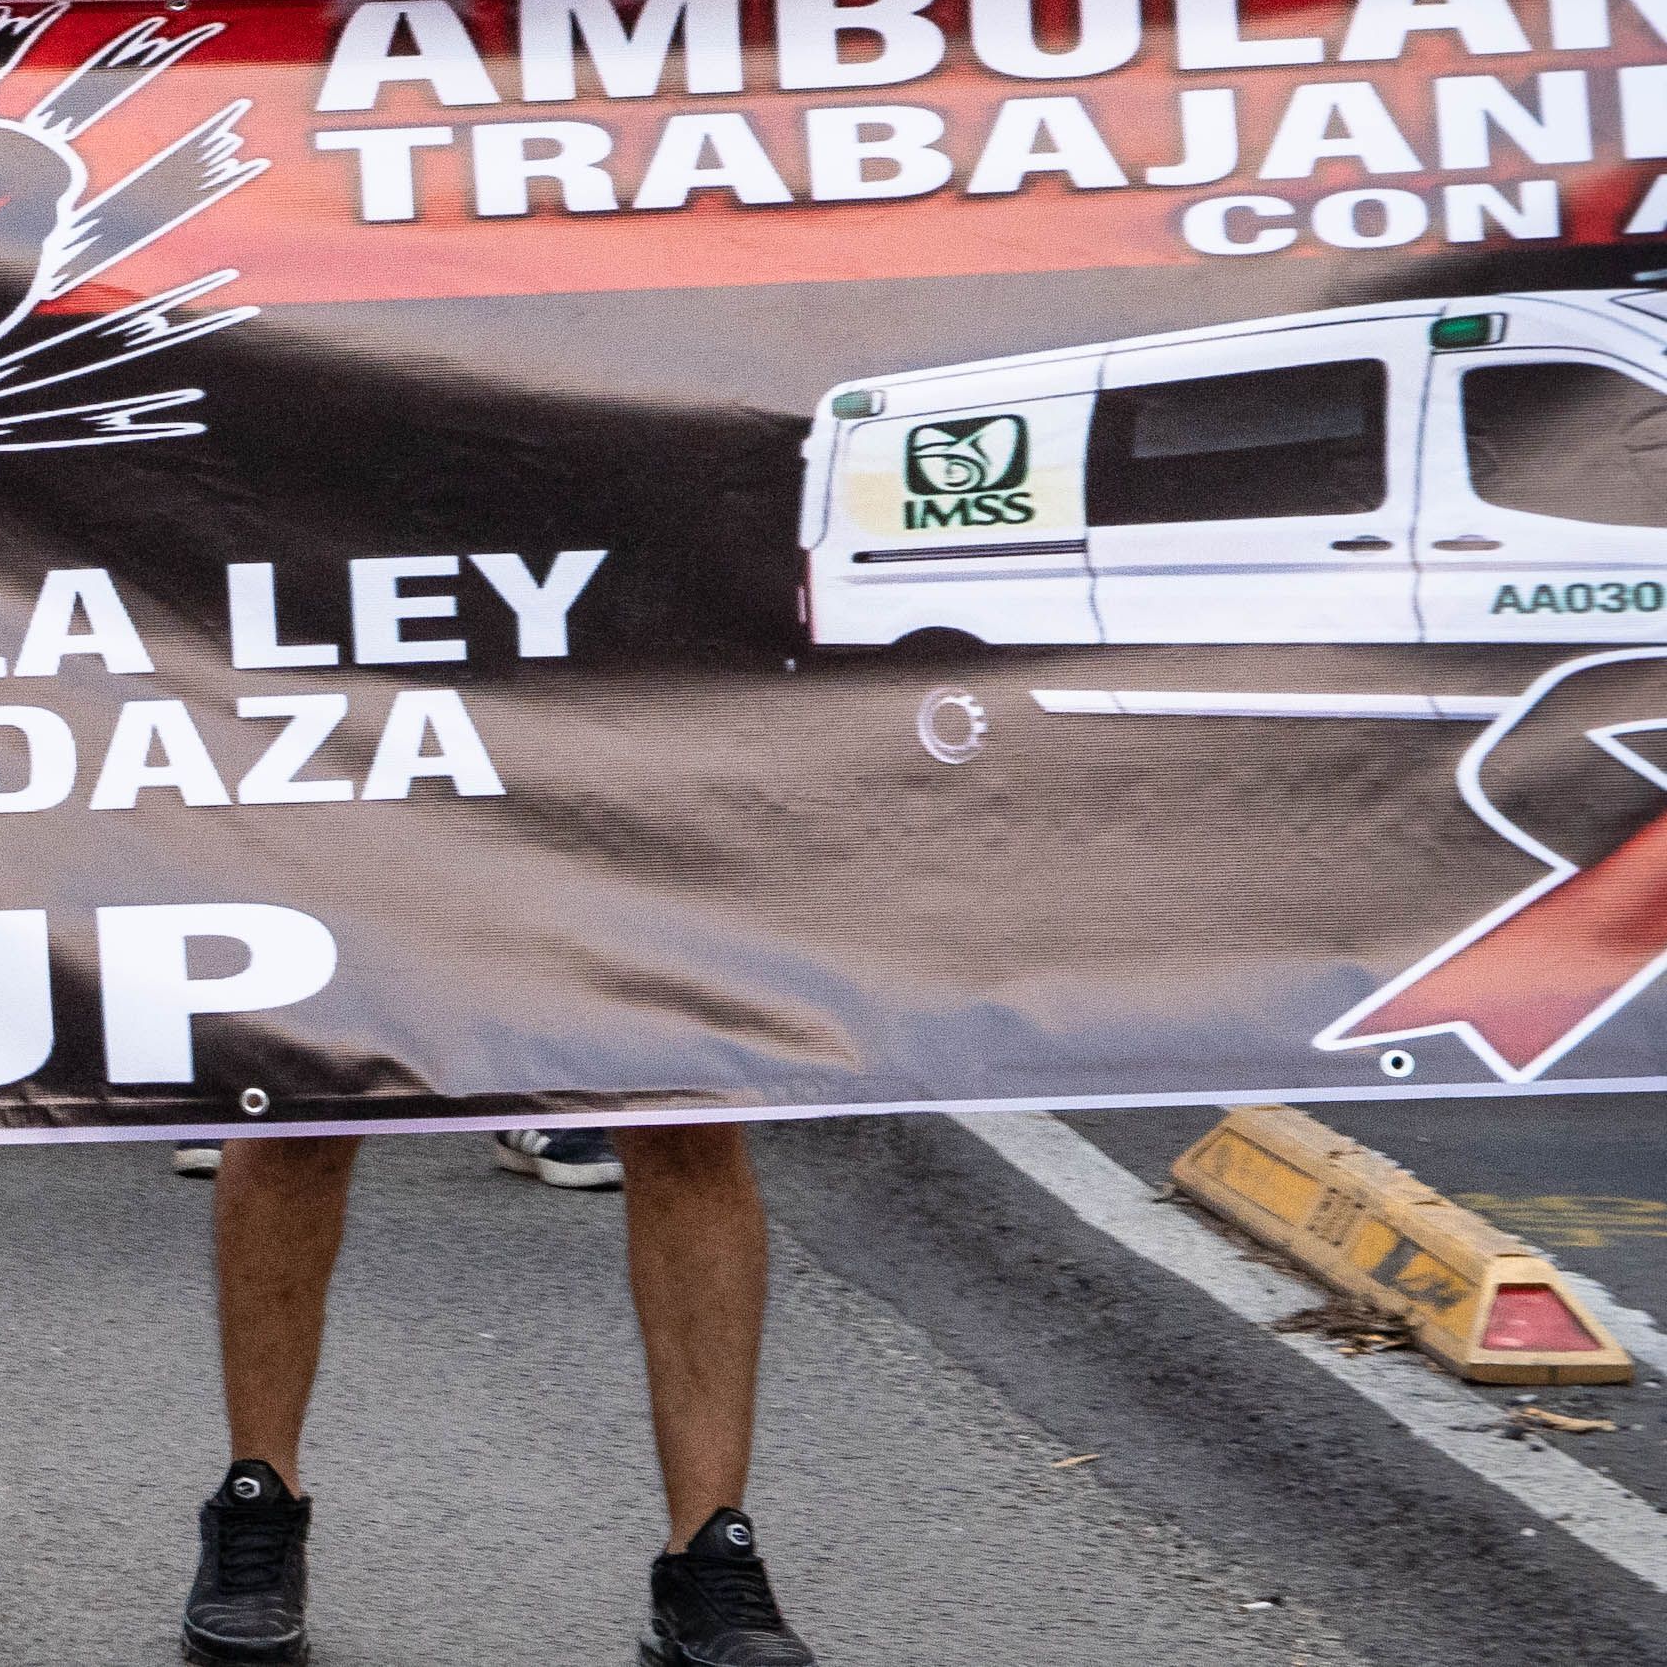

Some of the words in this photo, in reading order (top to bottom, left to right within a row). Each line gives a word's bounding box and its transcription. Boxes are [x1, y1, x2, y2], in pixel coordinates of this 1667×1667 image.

[1181, 179, 1559, 256] CON
[904, 492, 1035, 530] IMSS
[228, 550, 604, 669] LEY
[1490, 581, 1665, 615] AA030
